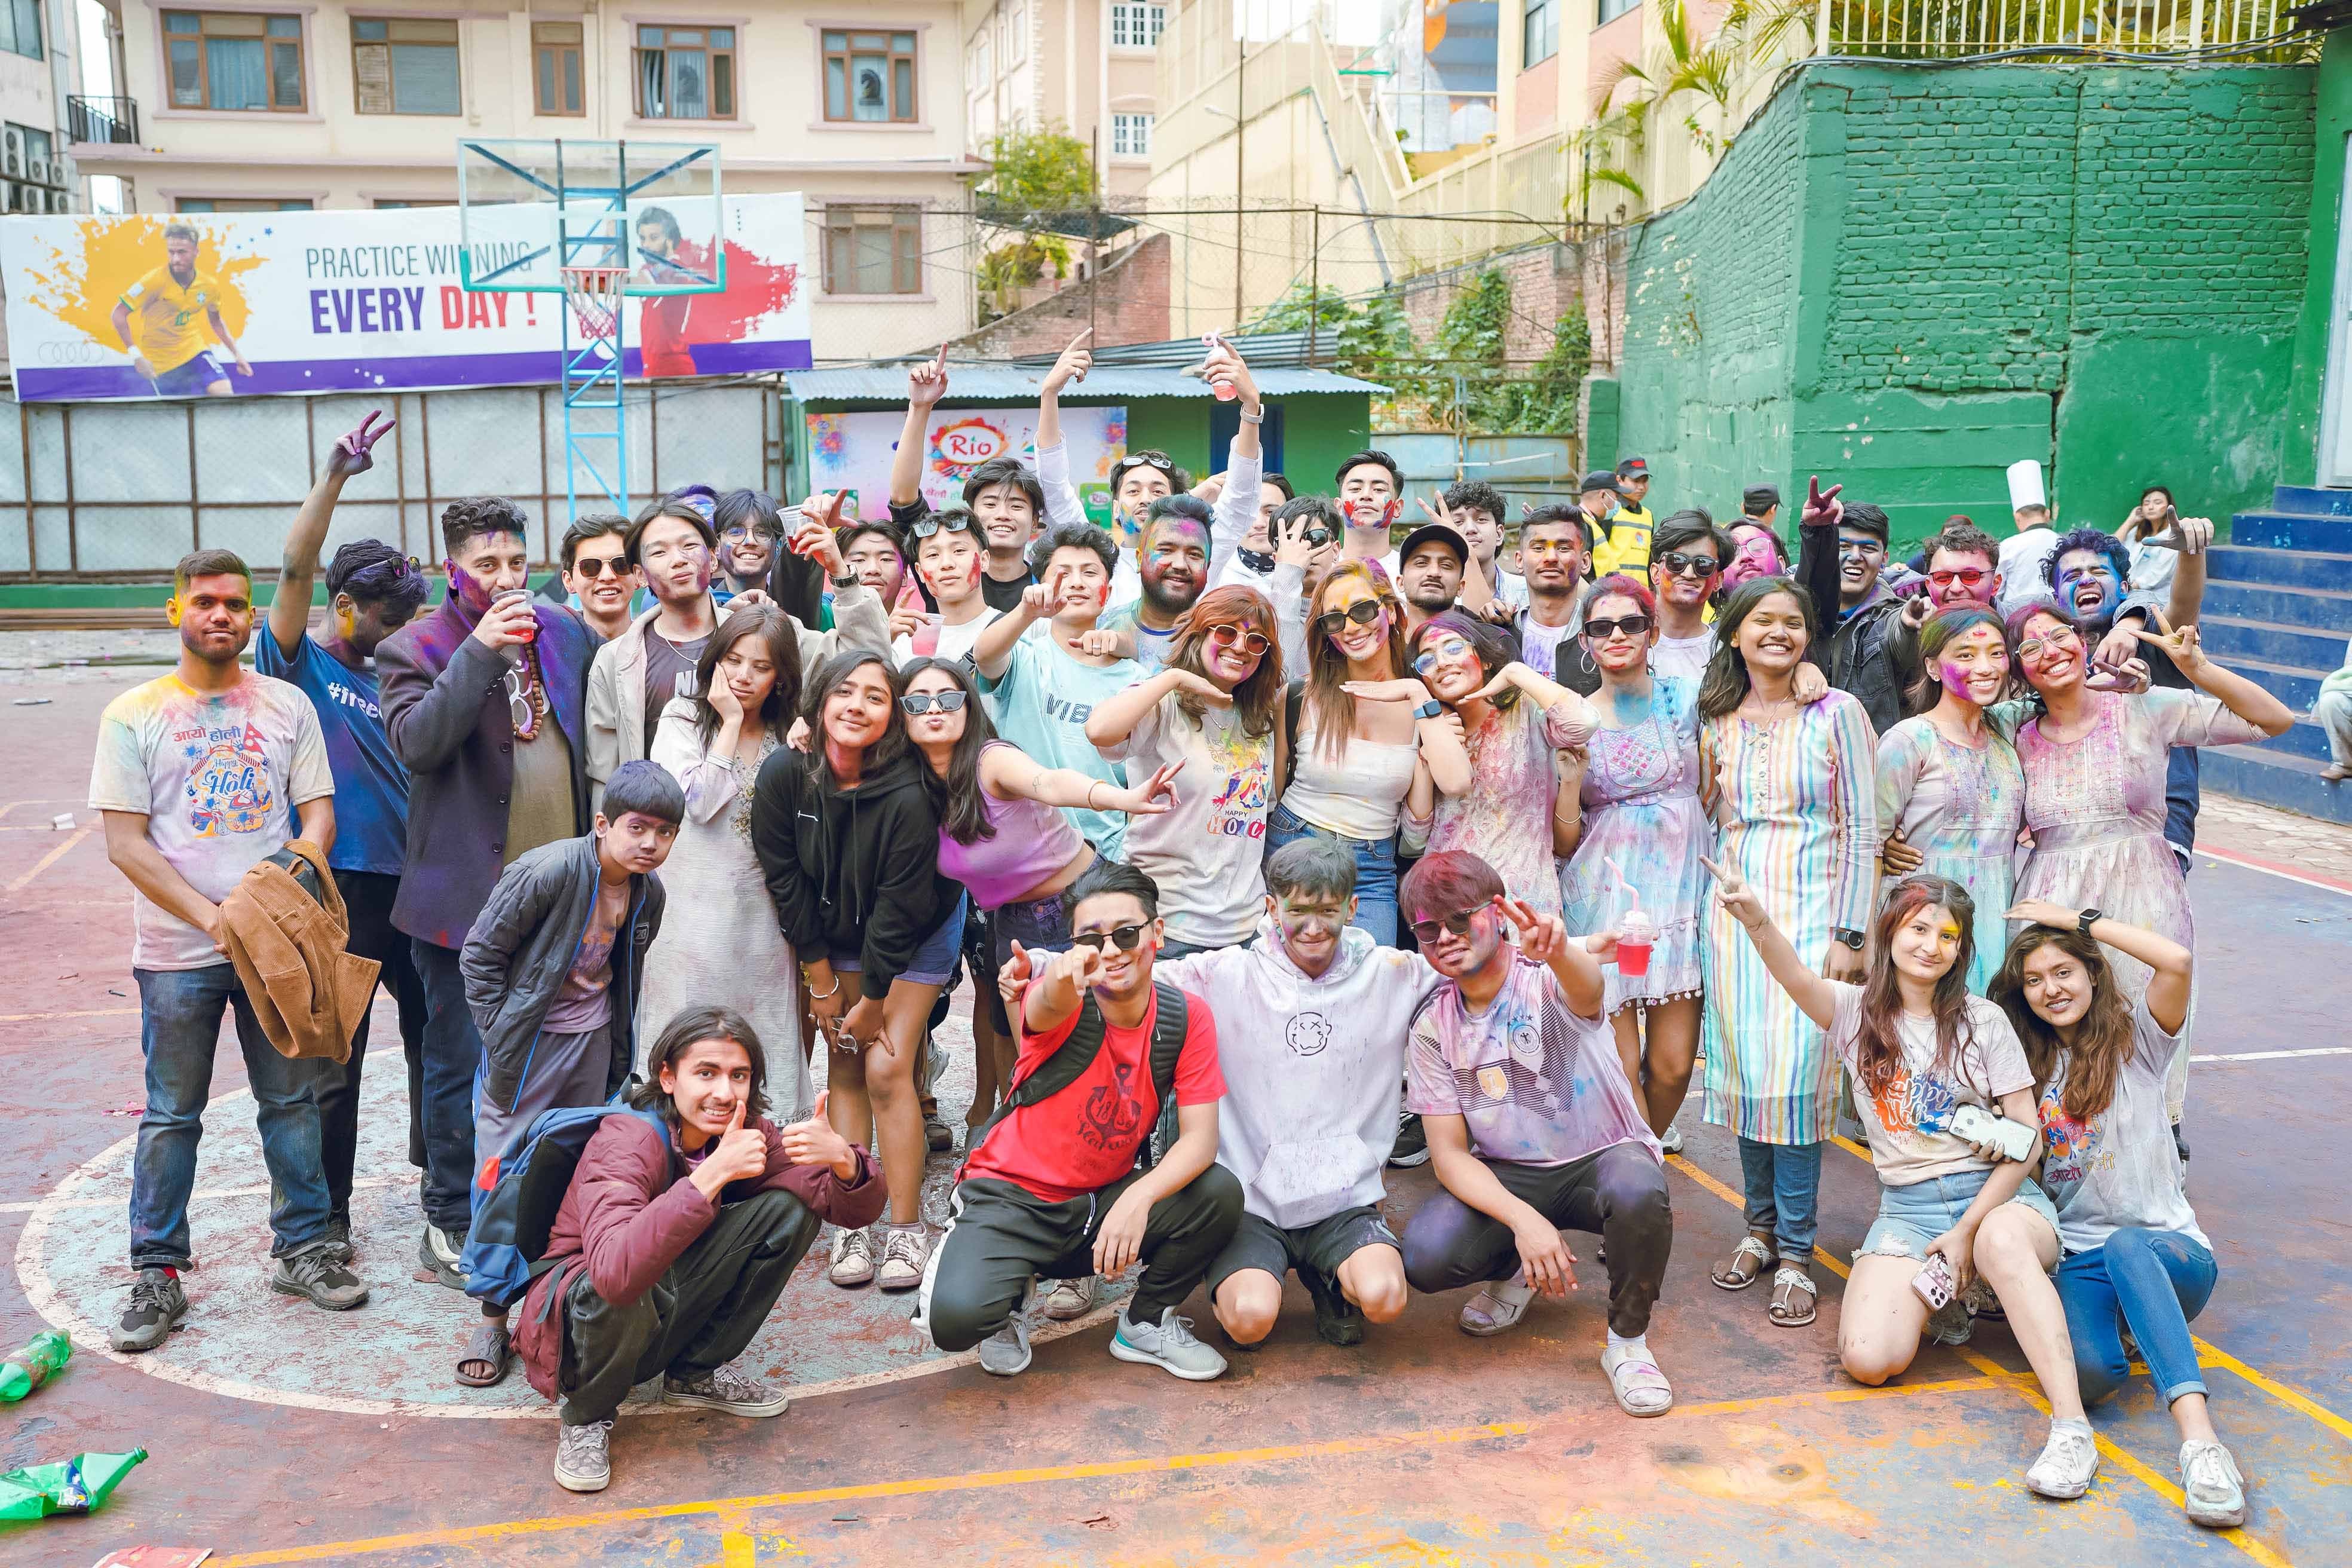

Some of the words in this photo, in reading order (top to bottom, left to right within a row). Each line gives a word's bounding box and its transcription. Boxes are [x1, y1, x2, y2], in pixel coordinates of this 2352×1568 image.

[306, 246, 418, 278] PRACTICE
[310, 287, 424, 334] EVERY
[440, 285, 509, 330] DAY
[949, 434, 992, 456] Rio
[327, 681, 383, 719] #free
[1047, 693, 1093, 724] VIB
[172, 725, 207, 742] आयो
[210, 725, 241, 742] होली
[202, 767, 255, 795] Holi
